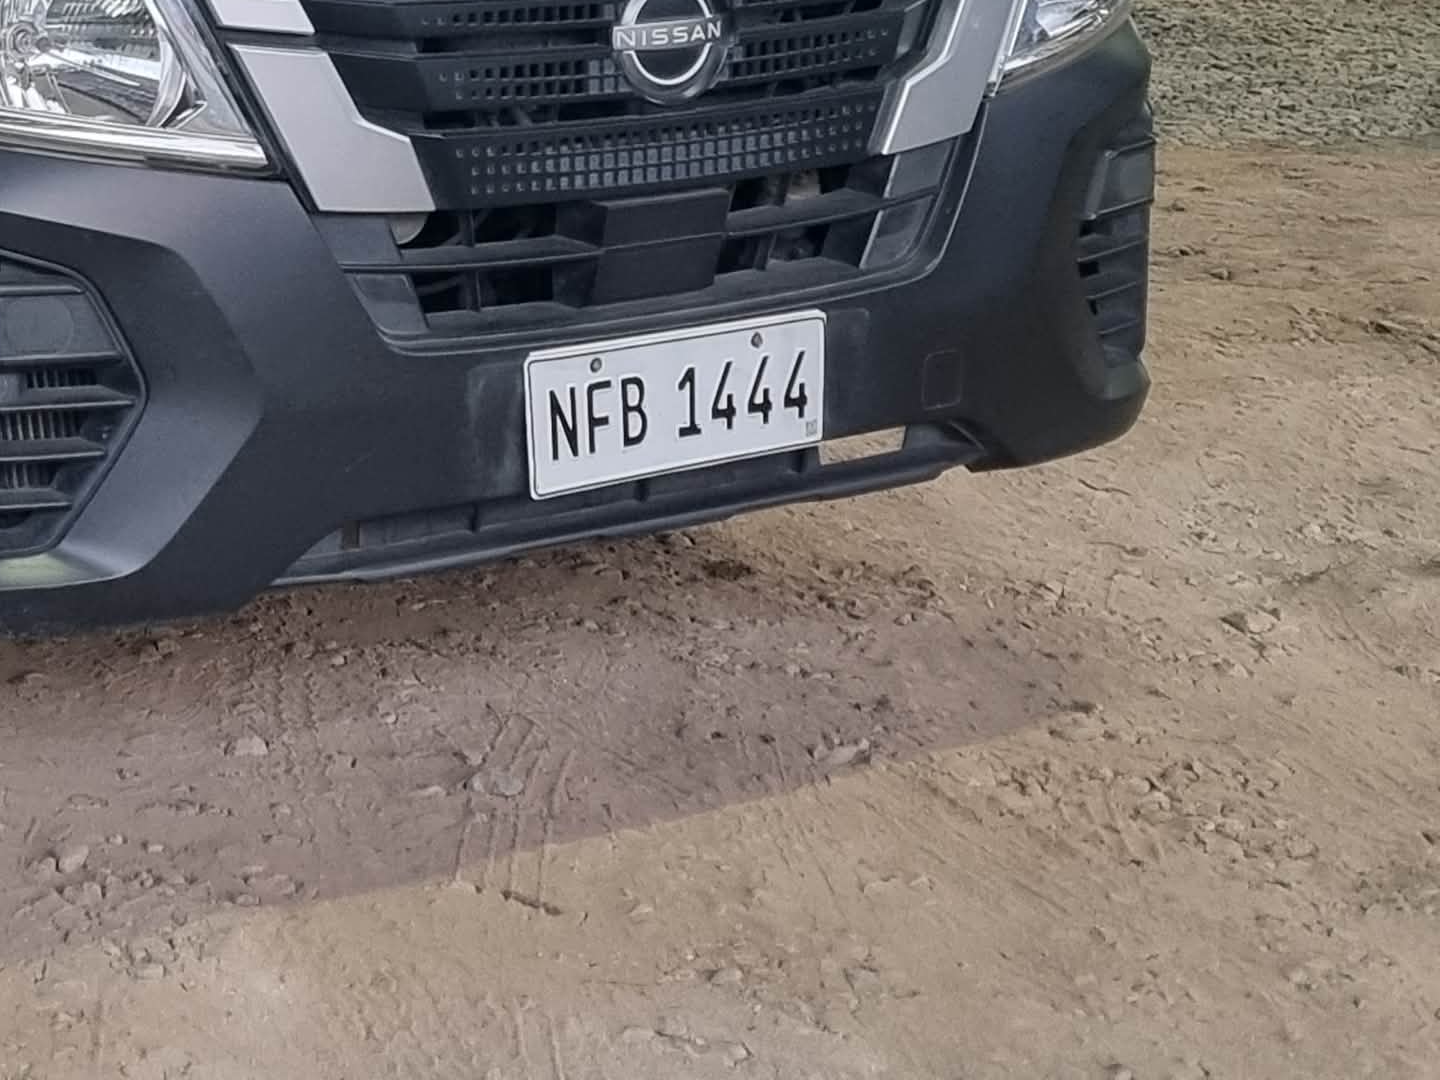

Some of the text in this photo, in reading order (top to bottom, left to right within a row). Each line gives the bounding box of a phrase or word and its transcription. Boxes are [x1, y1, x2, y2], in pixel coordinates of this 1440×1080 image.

[616, 20, 721, 47] NISSAN
[549, 350, 807, 461] NFB 1444
